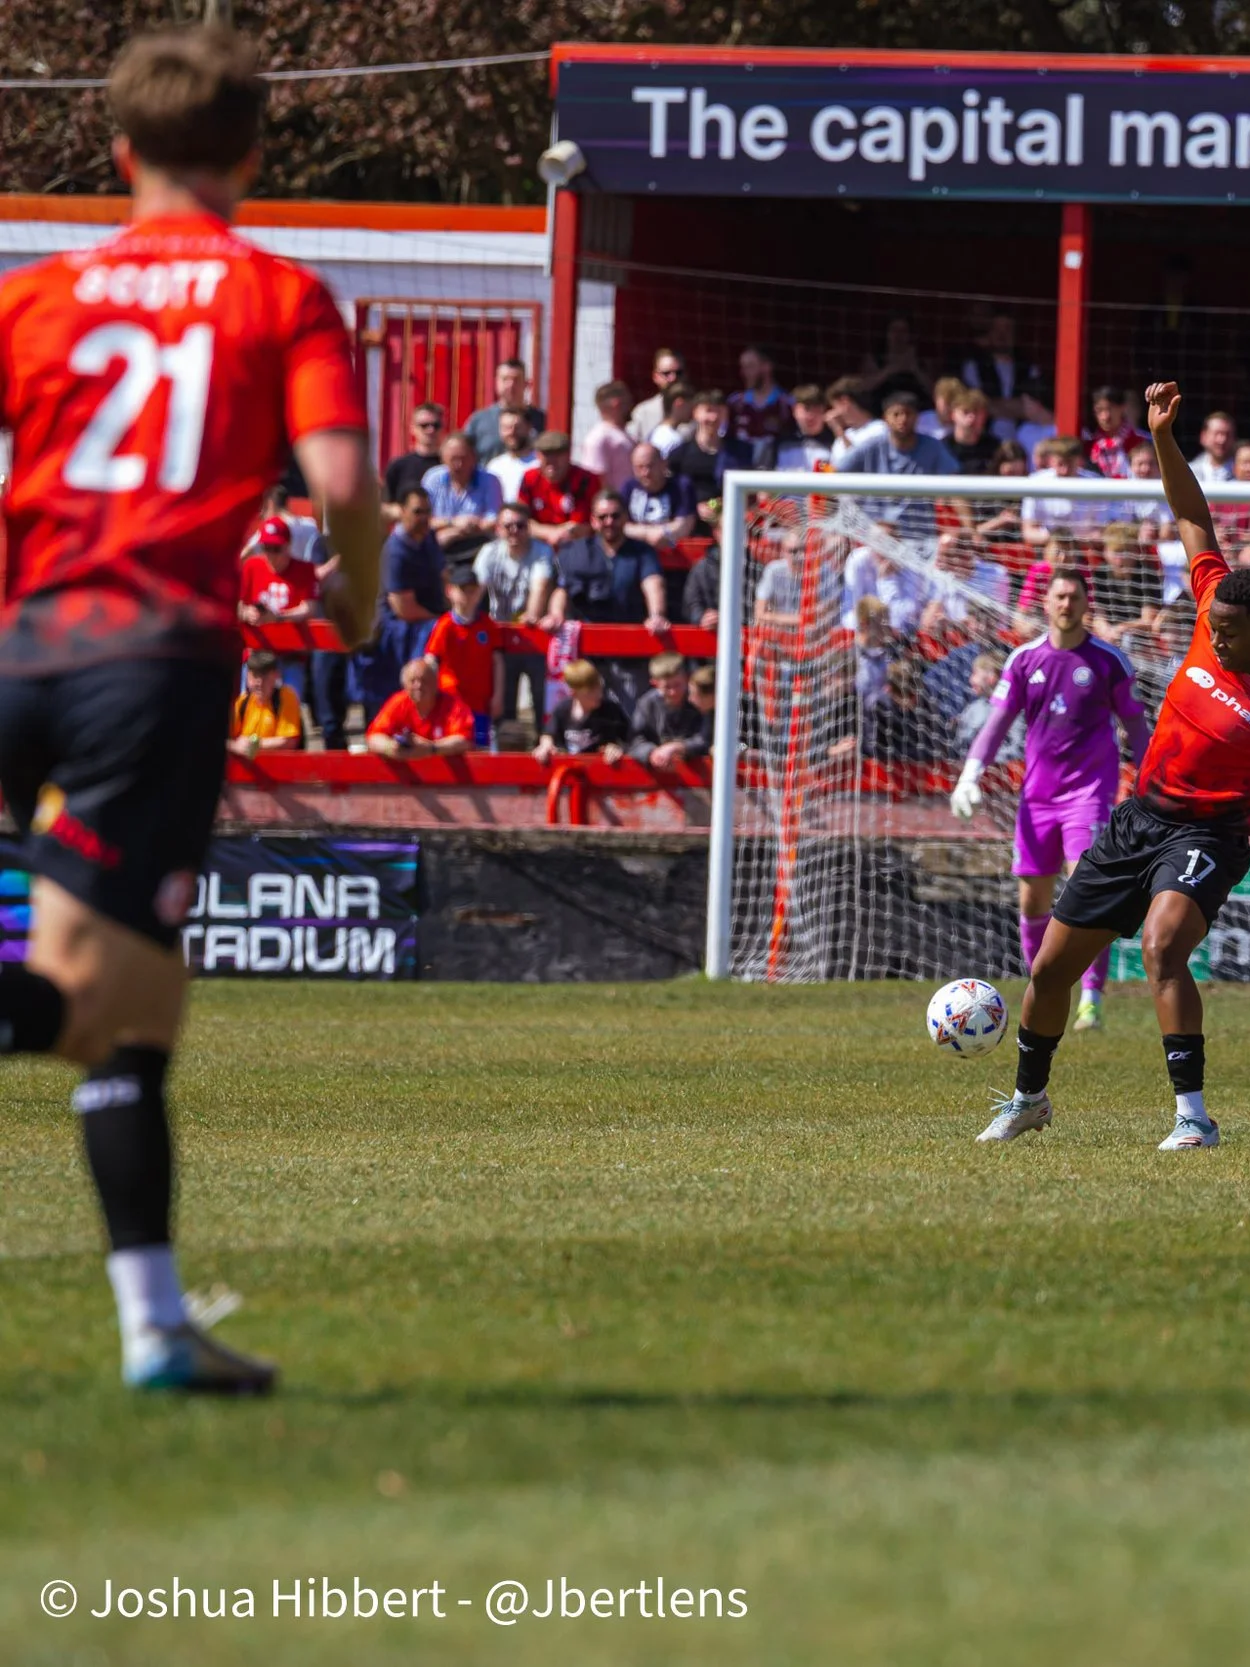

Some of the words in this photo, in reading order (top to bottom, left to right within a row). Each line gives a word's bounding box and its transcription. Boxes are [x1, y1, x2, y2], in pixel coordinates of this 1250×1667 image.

[633, 88, 787, 160] The
[812, 90, 1083, 181] capital
[62, 319, 215, 493] 21
[1185, 849, 1216, 880] 17
[186, 871, 380, 920] LANA
[180, 924, 396, 974] TADIUM
